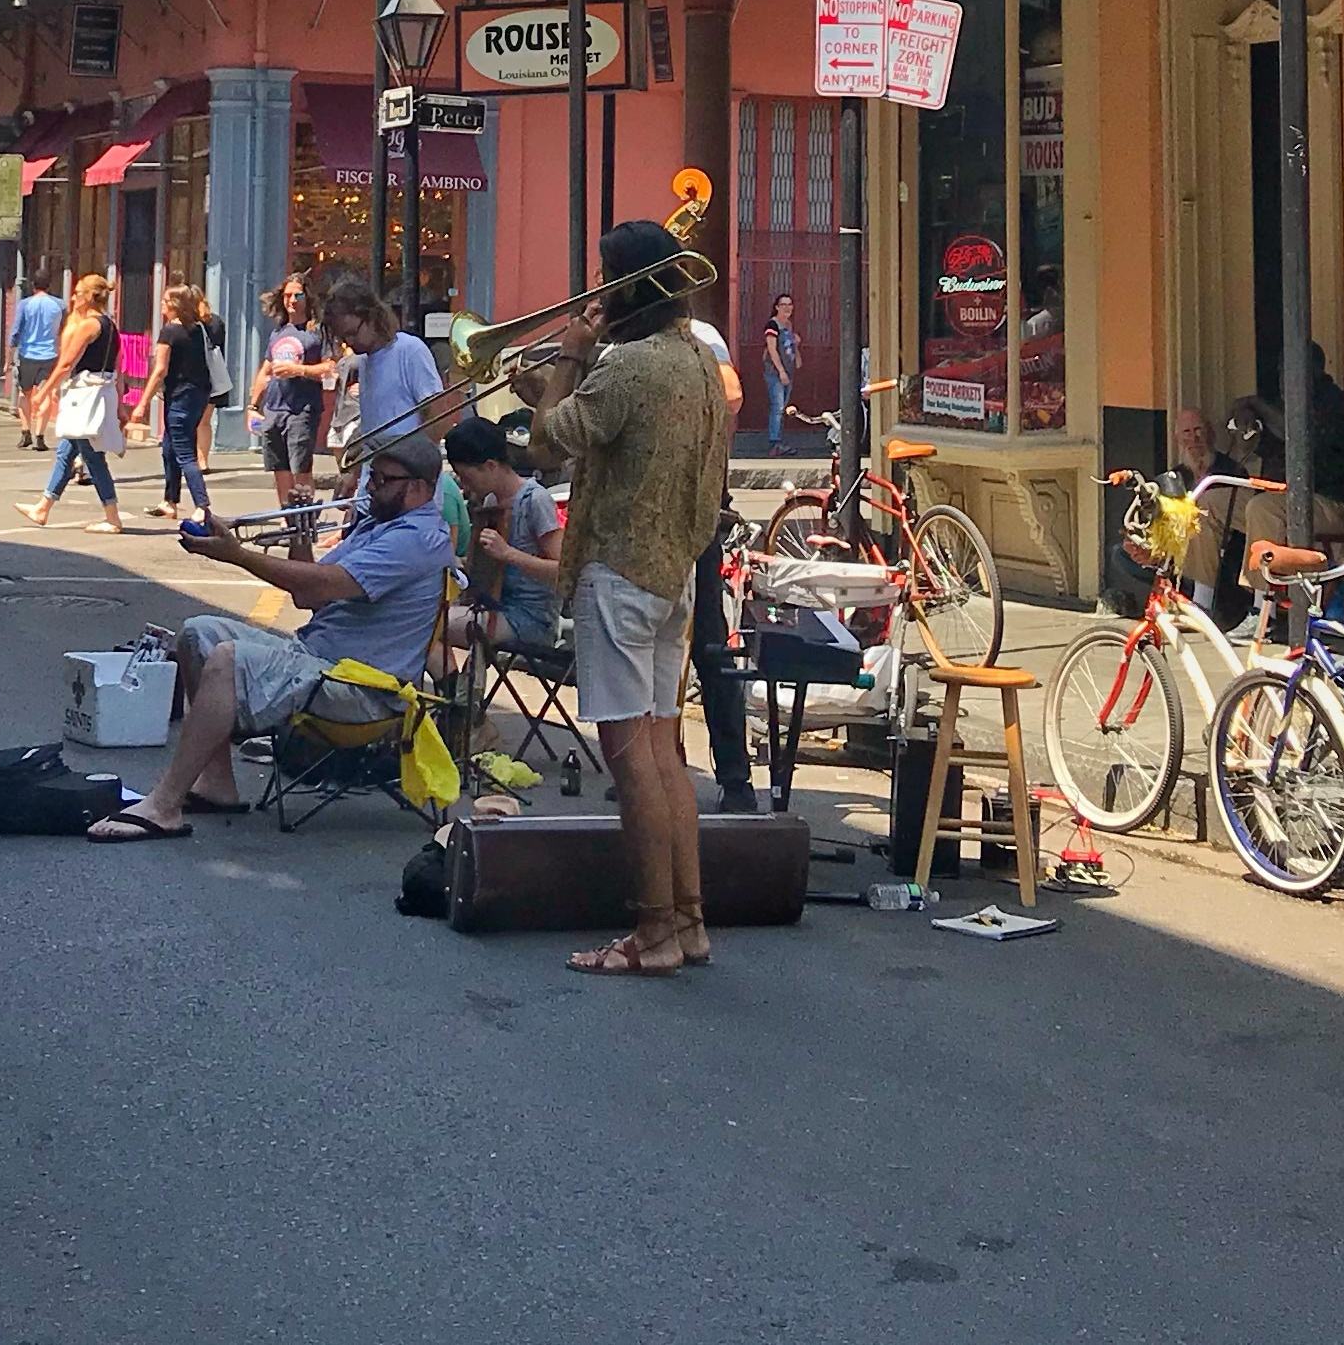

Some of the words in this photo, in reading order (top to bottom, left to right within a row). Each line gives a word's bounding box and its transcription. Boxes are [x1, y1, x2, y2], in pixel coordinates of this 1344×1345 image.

[840, 0, 884, 15] STOPPING
[888, 0, 910, 24] NO
[910, 8, 956, 30] PARKING
[484, 21, 593, 56] ROUSES
[843, 26, 860, 39] TO
[824, 42, 879, 55] CORNER
[890, 31, 948, 55] FREIGHT
[550, 52, 602, 66] MAET
[897, 48, 934, 69] ZONE
[498, 68, 548, 81] Louisiana
[822, 74, 880, 89] ANYTIME
[430, 106, 483, 127] Peter
[336, 169, 398, 187] FISCR
[420, 174, 482, 190] AMBINO
[938, 276, 1007, 293] Budweiser
[64, 708, 93, 733] SAINTS
